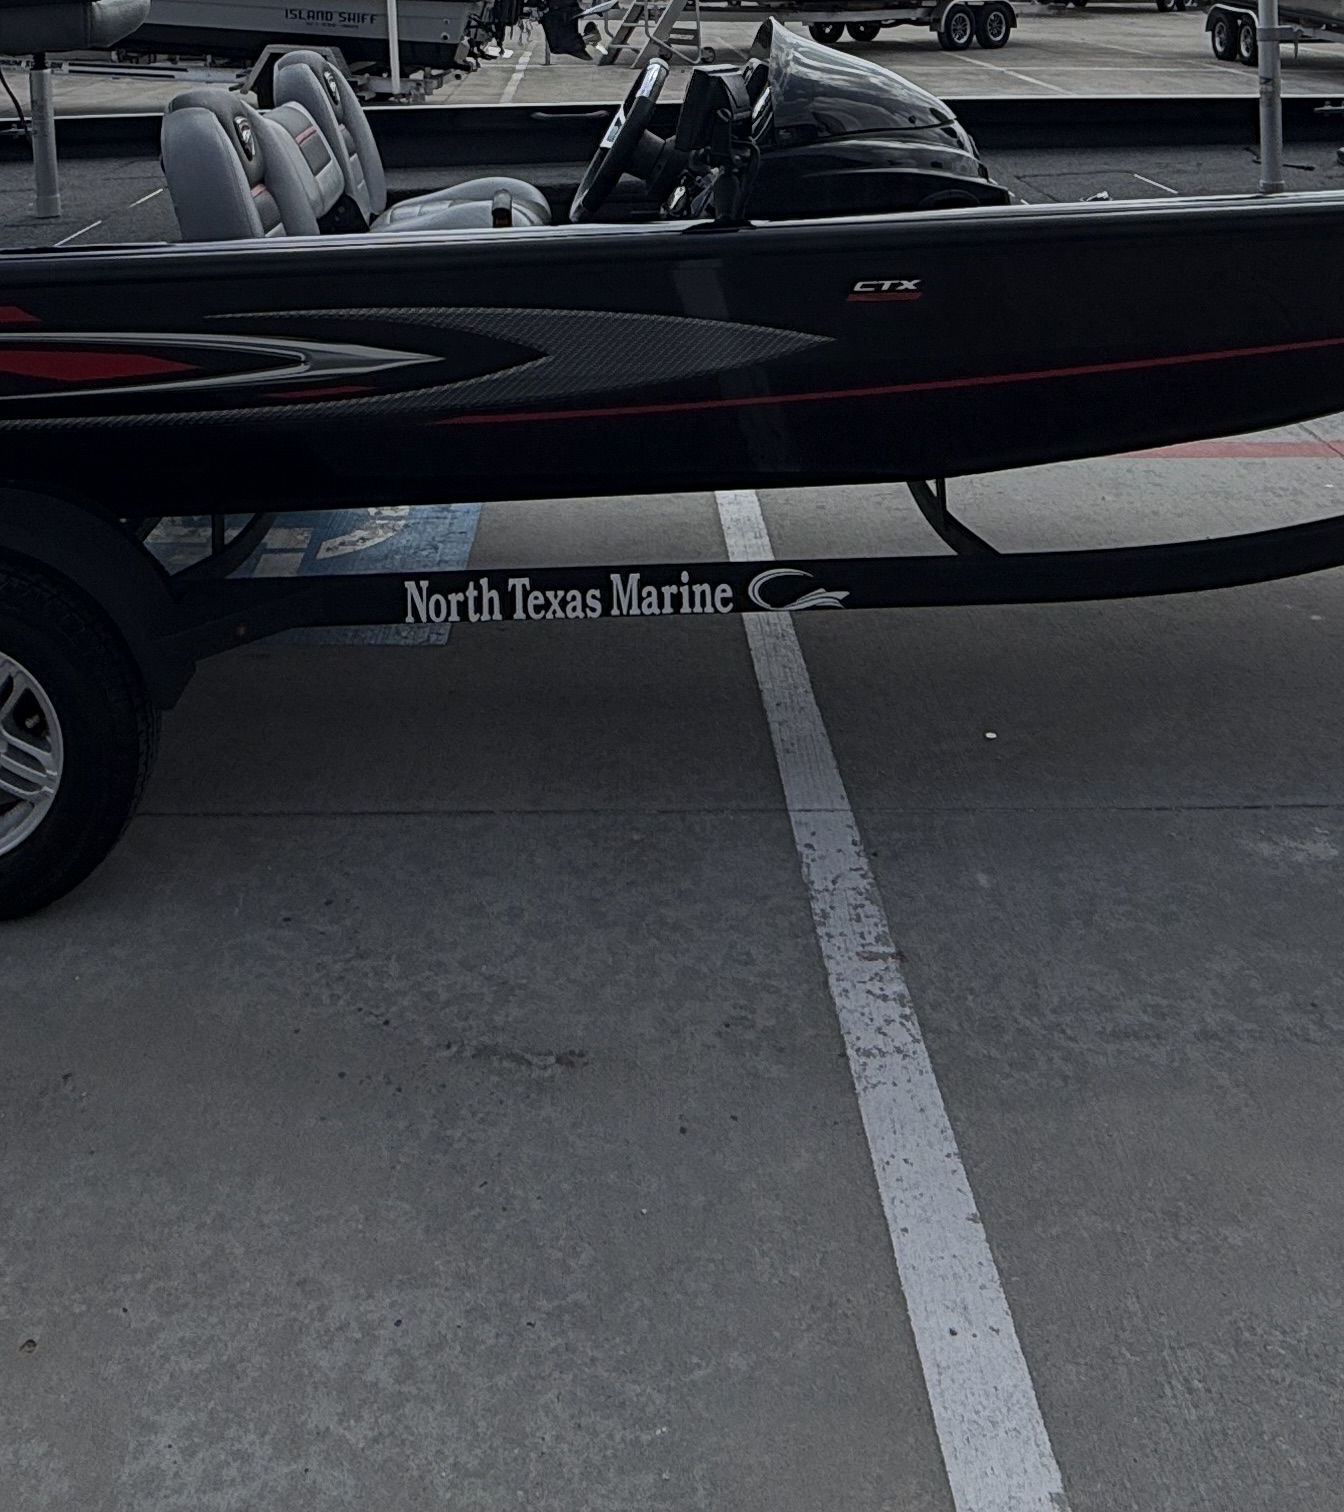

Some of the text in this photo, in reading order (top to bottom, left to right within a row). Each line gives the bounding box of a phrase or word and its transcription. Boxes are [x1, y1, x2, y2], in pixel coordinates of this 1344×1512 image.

[285, 8, 334, 22] ISLAND
[853, 279, 921, 292] CTX
[404, 570, 734, 624] North Texas Marine
